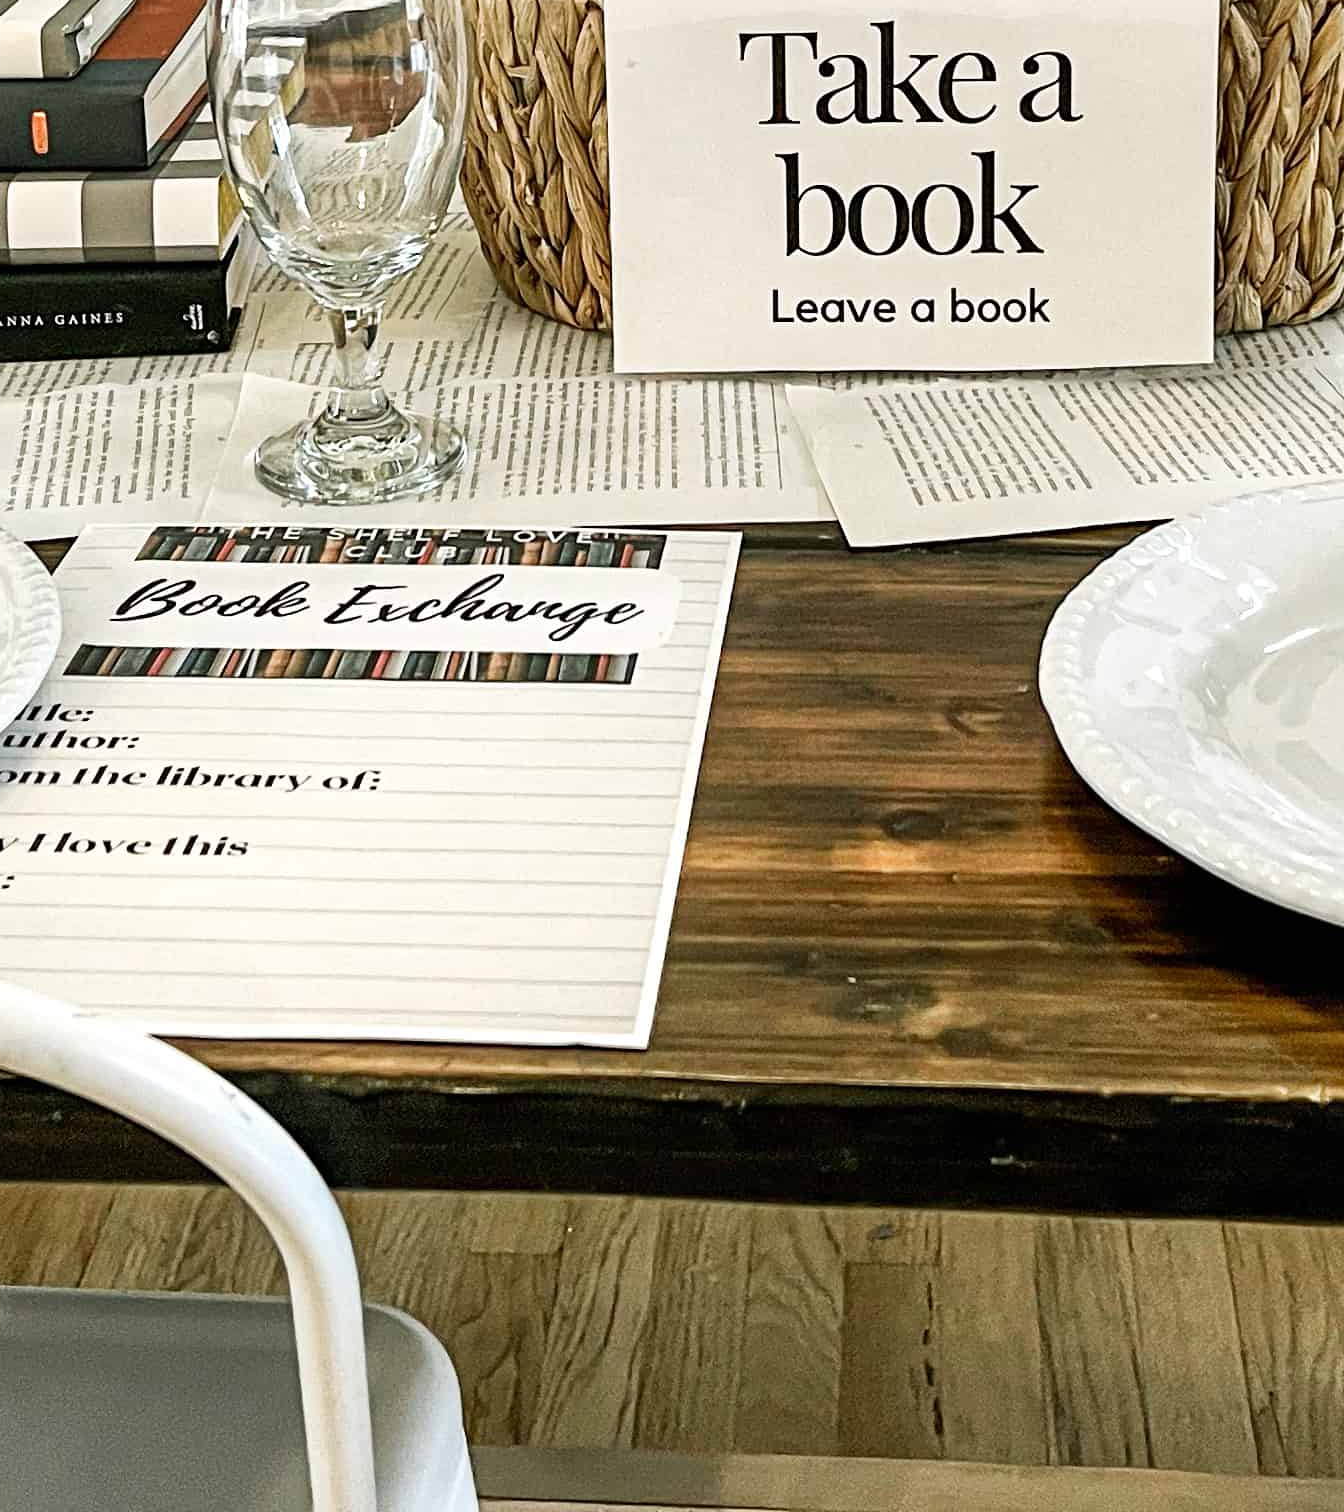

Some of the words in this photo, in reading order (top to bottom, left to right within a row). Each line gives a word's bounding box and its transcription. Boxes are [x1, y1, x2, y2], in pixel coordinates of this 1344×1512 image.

[739, 20, 998, 125] Take
[1019, 50, 1084, 123] a
[774, 150, 1045, 258] book
[54, 312, 125, 326] GAINES
[771, 288, 897, 324] Leave
[910, 296, 936, 324] a
[951, 287, 1051, 324] book
[325, 528, 460, 542] SHELF
[485, 530, 594, 545] LOVE
[344, 545, 458, 562] CLUB
[109, 577, 313, 622] Book
[323, 573, 644, 643] Exchange
[72, 765, 147, 787] the
[155, 765, 312, 793] library
[27, 832, 48, 853] I
[54, 832, 152, 856] love
[161, 834, 250, 857] this
